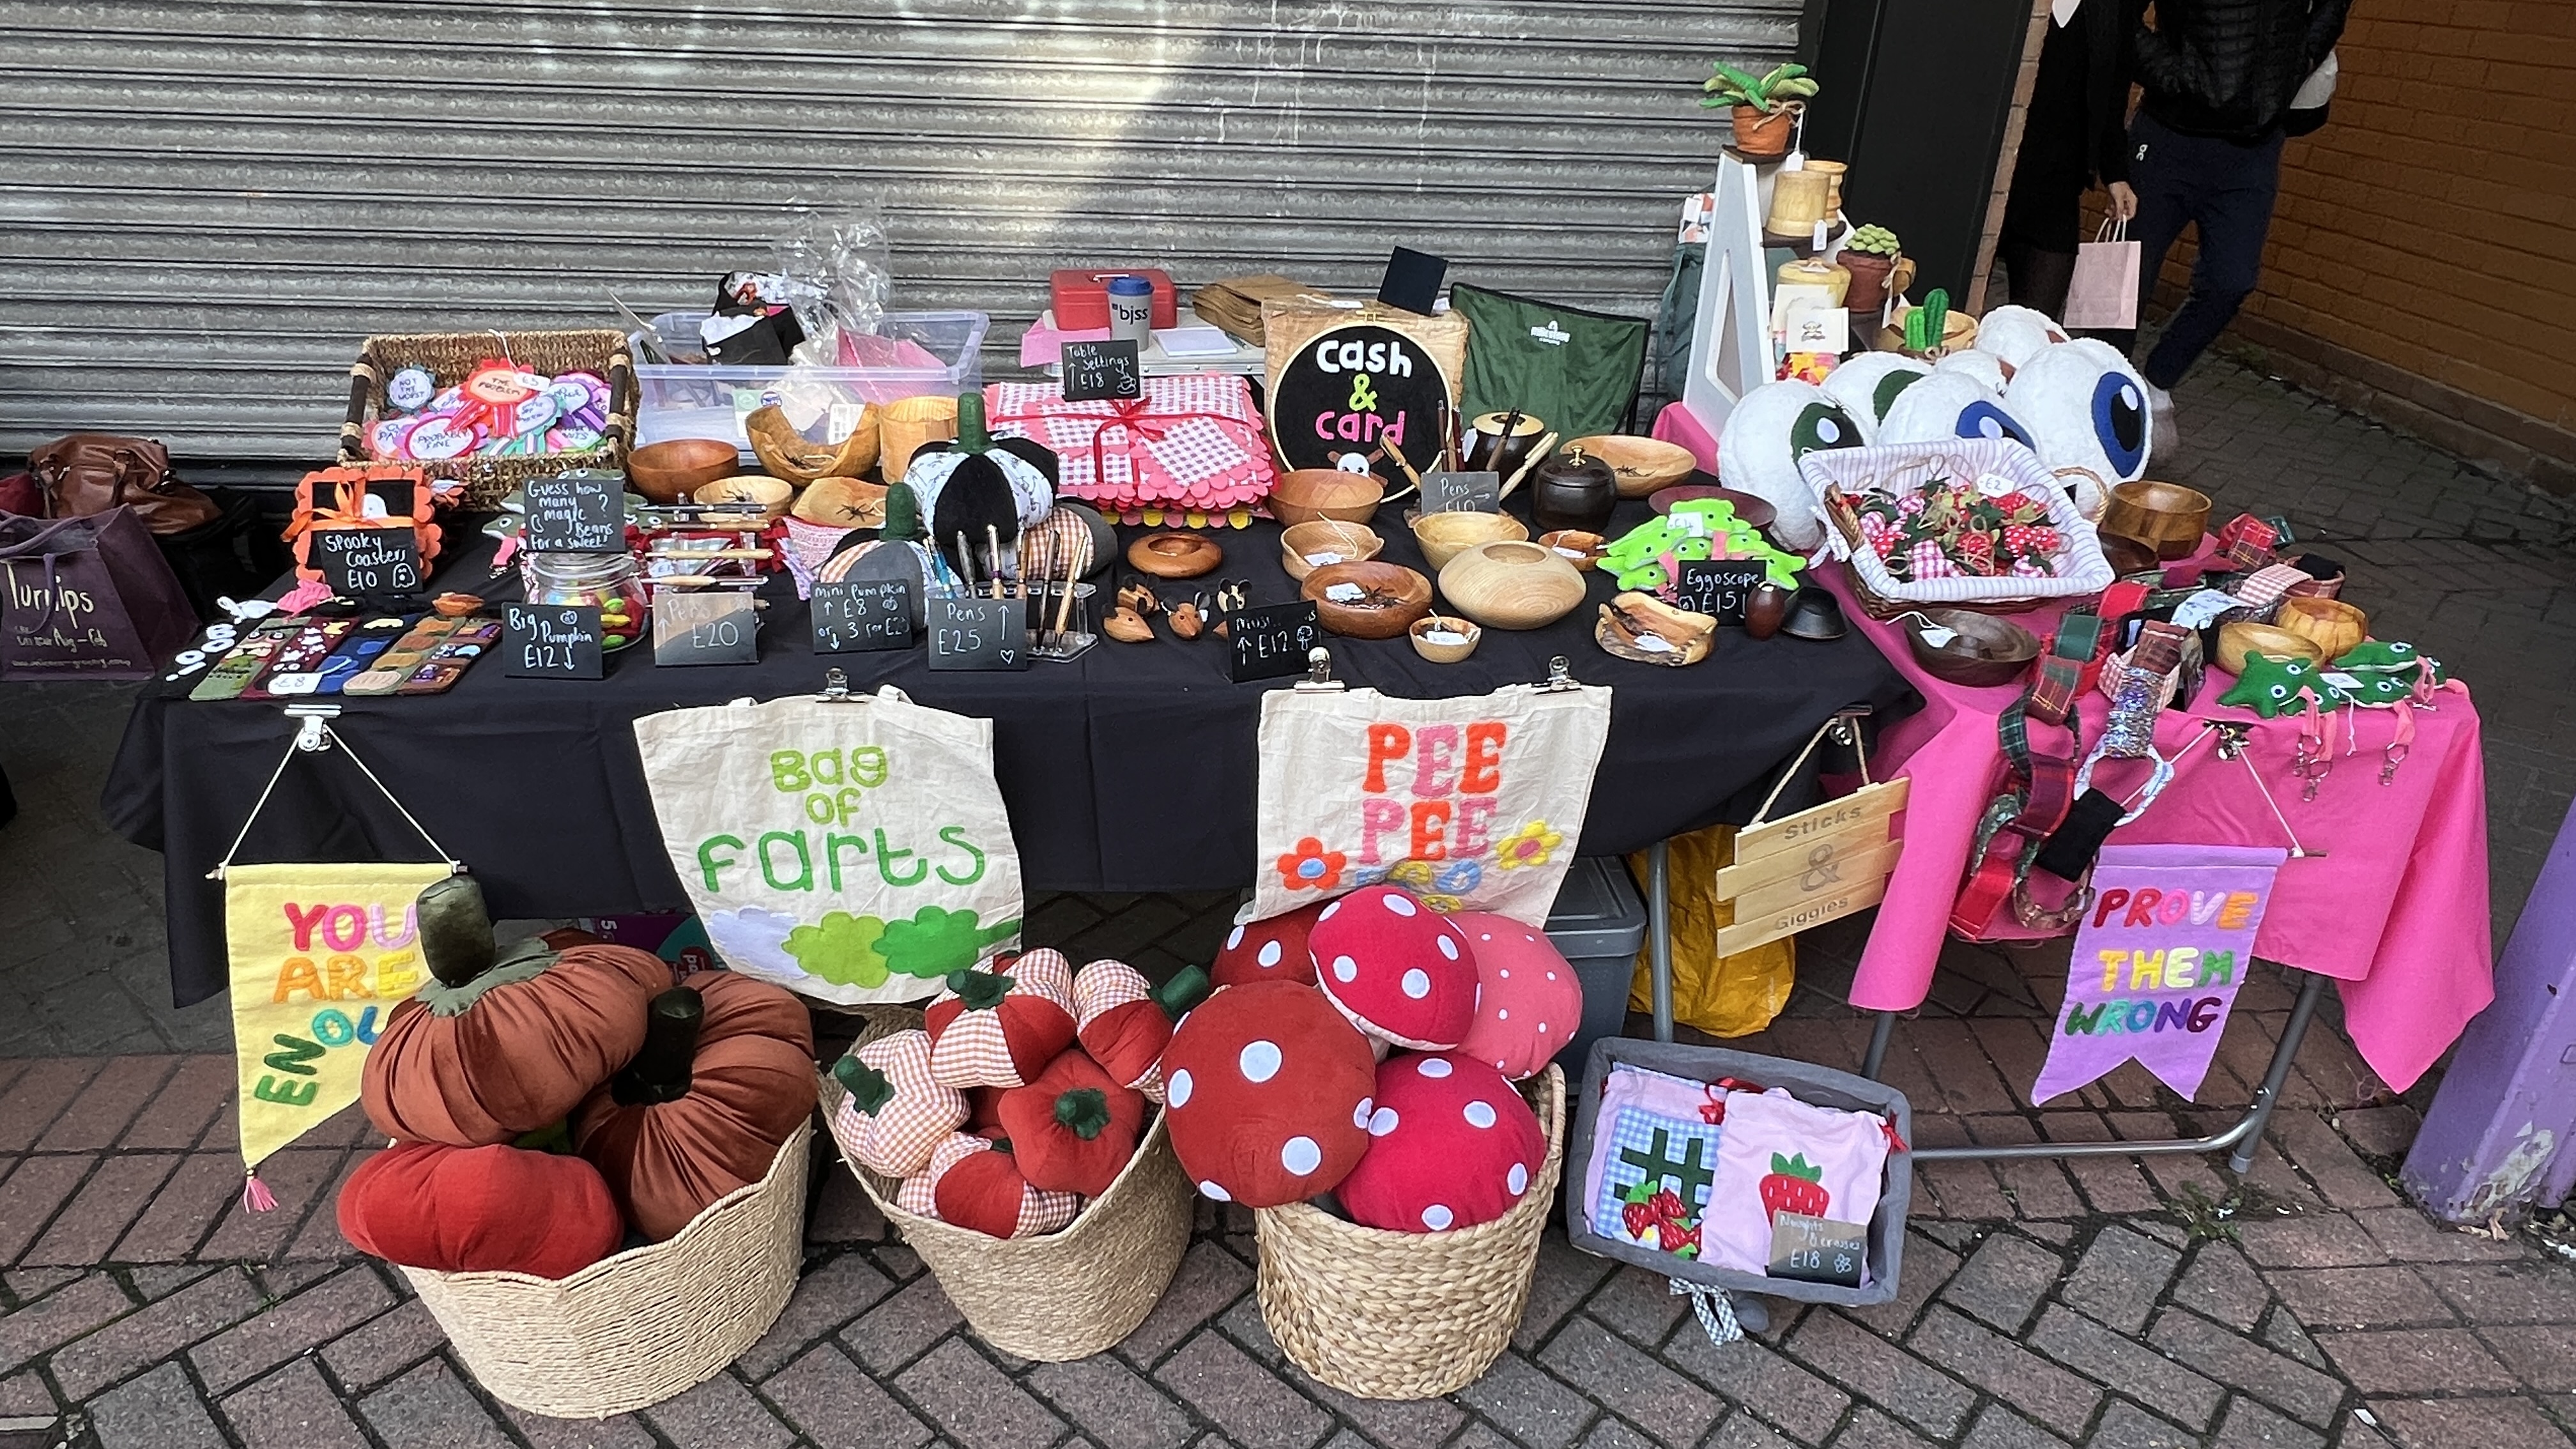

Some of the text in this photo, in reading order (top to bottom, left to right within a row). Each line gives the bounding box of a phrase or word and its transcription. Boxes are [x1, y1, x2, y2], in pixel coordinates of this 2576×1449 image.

[1119, 304, 1149, 325] bjss
[1066, 344, 1098, 358] Table
[1316, 339, 1413, 378] cash
[1349, 373, 1377, 411] &
[1315, 410, 1406, 446] card
[528, 480, 602, 498] Guess how
[1439, 477, 1470, 497] Pens
[1687, 568, 1759, 592] Eggoscope
[509, 608, 538, 641] Big
[947, 602, 986, 622] Pens
[540, 620, 593, 648] Pumpkin
[847, 622, 859, 639] 3
[770, 746, 888, 793] Bag
[1361, 720, 1508, 799] PEE
[1357, 797, 1498, 866] PEE
[1783, 806, 1862, 841] Sticks
[1800, 843, 1842, 892] &
[284, 901, 418, 953] YOU
[1775, 898, 1848, 930] Giggles
[2093, 888, 2258, 930] PROVE
[273, 950, 418, 1004] ARE
[2099, 946, 2235, 992] THEM
[2064, 997, 2223, 1036] WRONG
